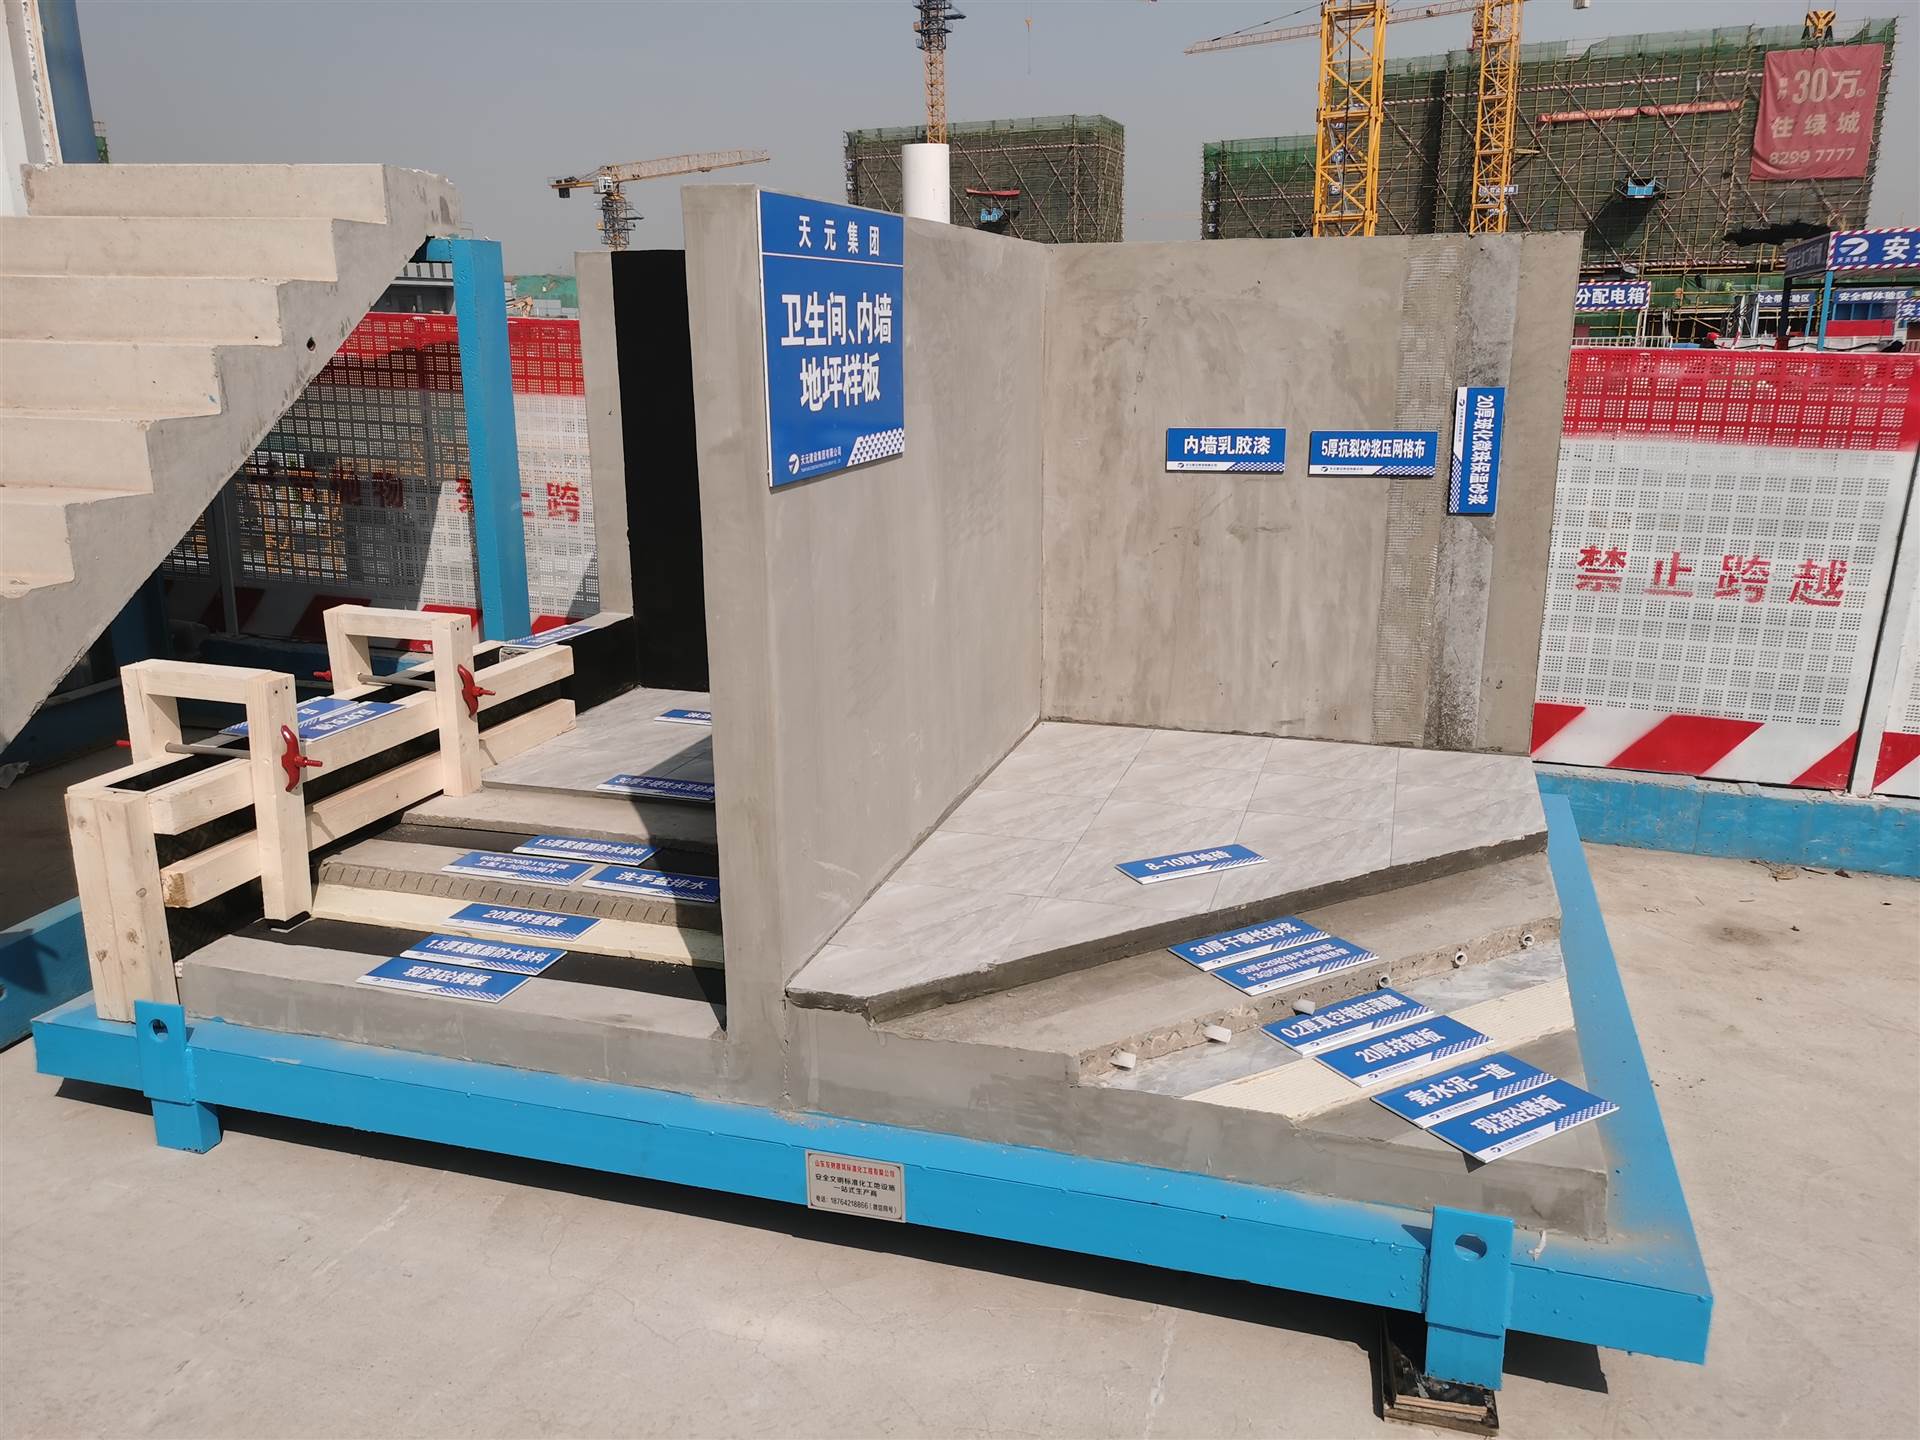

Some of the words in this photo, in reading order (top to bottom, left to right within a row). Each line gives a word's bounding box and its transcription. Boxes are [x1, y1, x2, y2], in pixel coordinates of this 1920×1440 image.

[1815, 147, 1856, 162] 7777
[798, 215, 880, 257] 天元集团
[1882, 235, 1920, 262] 安
[1576, 287, 1646, 305] 分配电箱
[1758, 292, 1810, 304] 安全带验区
[800, 352, 881, 412] 地坪样板
[1183, 435, 1271, 456] 内墙乳胶漆
[1321, 438, 1426, 459] 5厚抗裂砂浆压网格布
[1574, 545, 1847, 607] 禁止跨越
[615, 870, 709, 890] 洗手盆排水
[482, 909, 568, 928] 20厚挤塑板
[1189, 921, 1301, 957] 30厚干硬性砂浆
[1354, 1027, 1447, 1064] 20厚挤塑板
[1404, 1062, 1517, 1108] 素水泥一道
[1470, 1094, 1567, 1136] 现浇砼楼板
